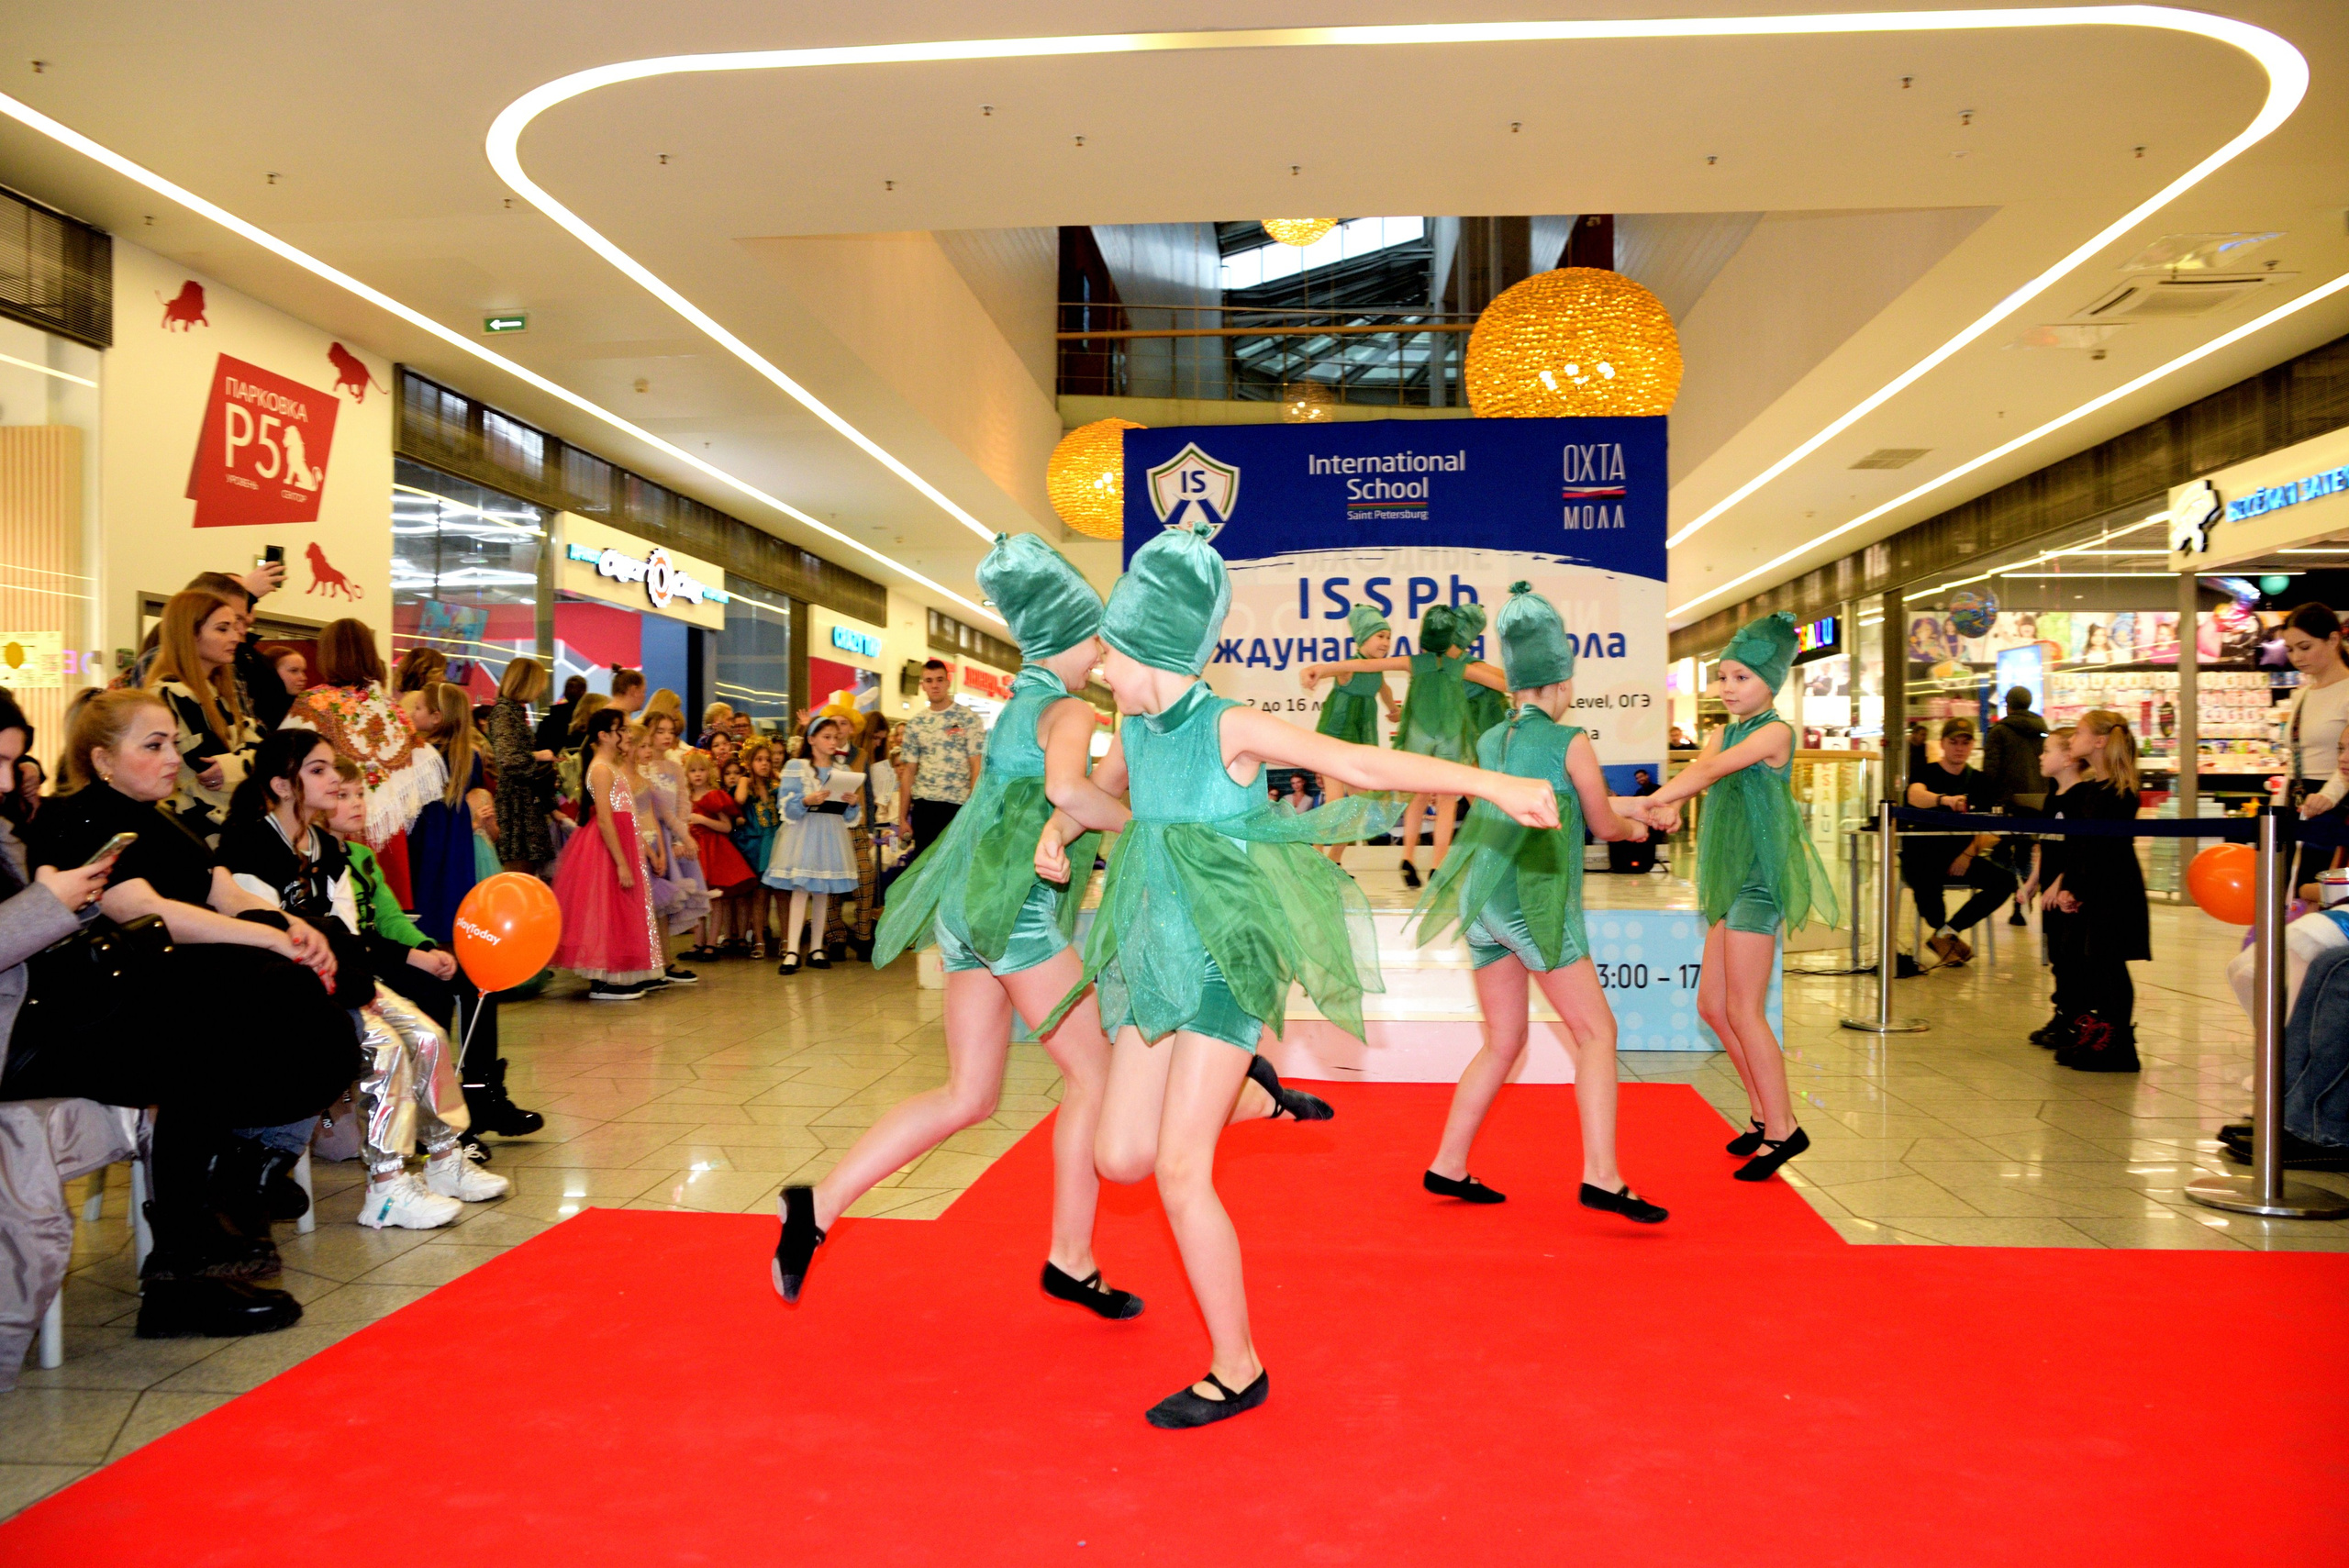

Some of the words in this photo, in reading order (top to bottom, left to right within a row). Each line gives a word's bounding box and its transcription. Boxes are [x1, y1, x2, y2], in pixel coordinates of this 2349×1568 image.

[225, 376, 309, 423] ПАРКОВКА
[1308, 450, 1466, 475] International
[1564, 443, 1626, 483] ОХТА
[1180, 470, 1206, 494] IS
[1346, 477, 1430, 500] School
[2299, 463, 2349, 502] ЗАТЕ
[1346, 510, 1373, 521] Saint
[1374, 509, 1430, 521] Petersburg
[1564, 505, 1626, 530] МОЛЛ
[1794, 616, 1834, 653] SALU
[1262, 701, 1281, 713] до
[1286, 698, 1307, 712] 16
[1618, 694, 1651, 708] ОГЭ
[1596, 963, 1649, 989] 3:00
